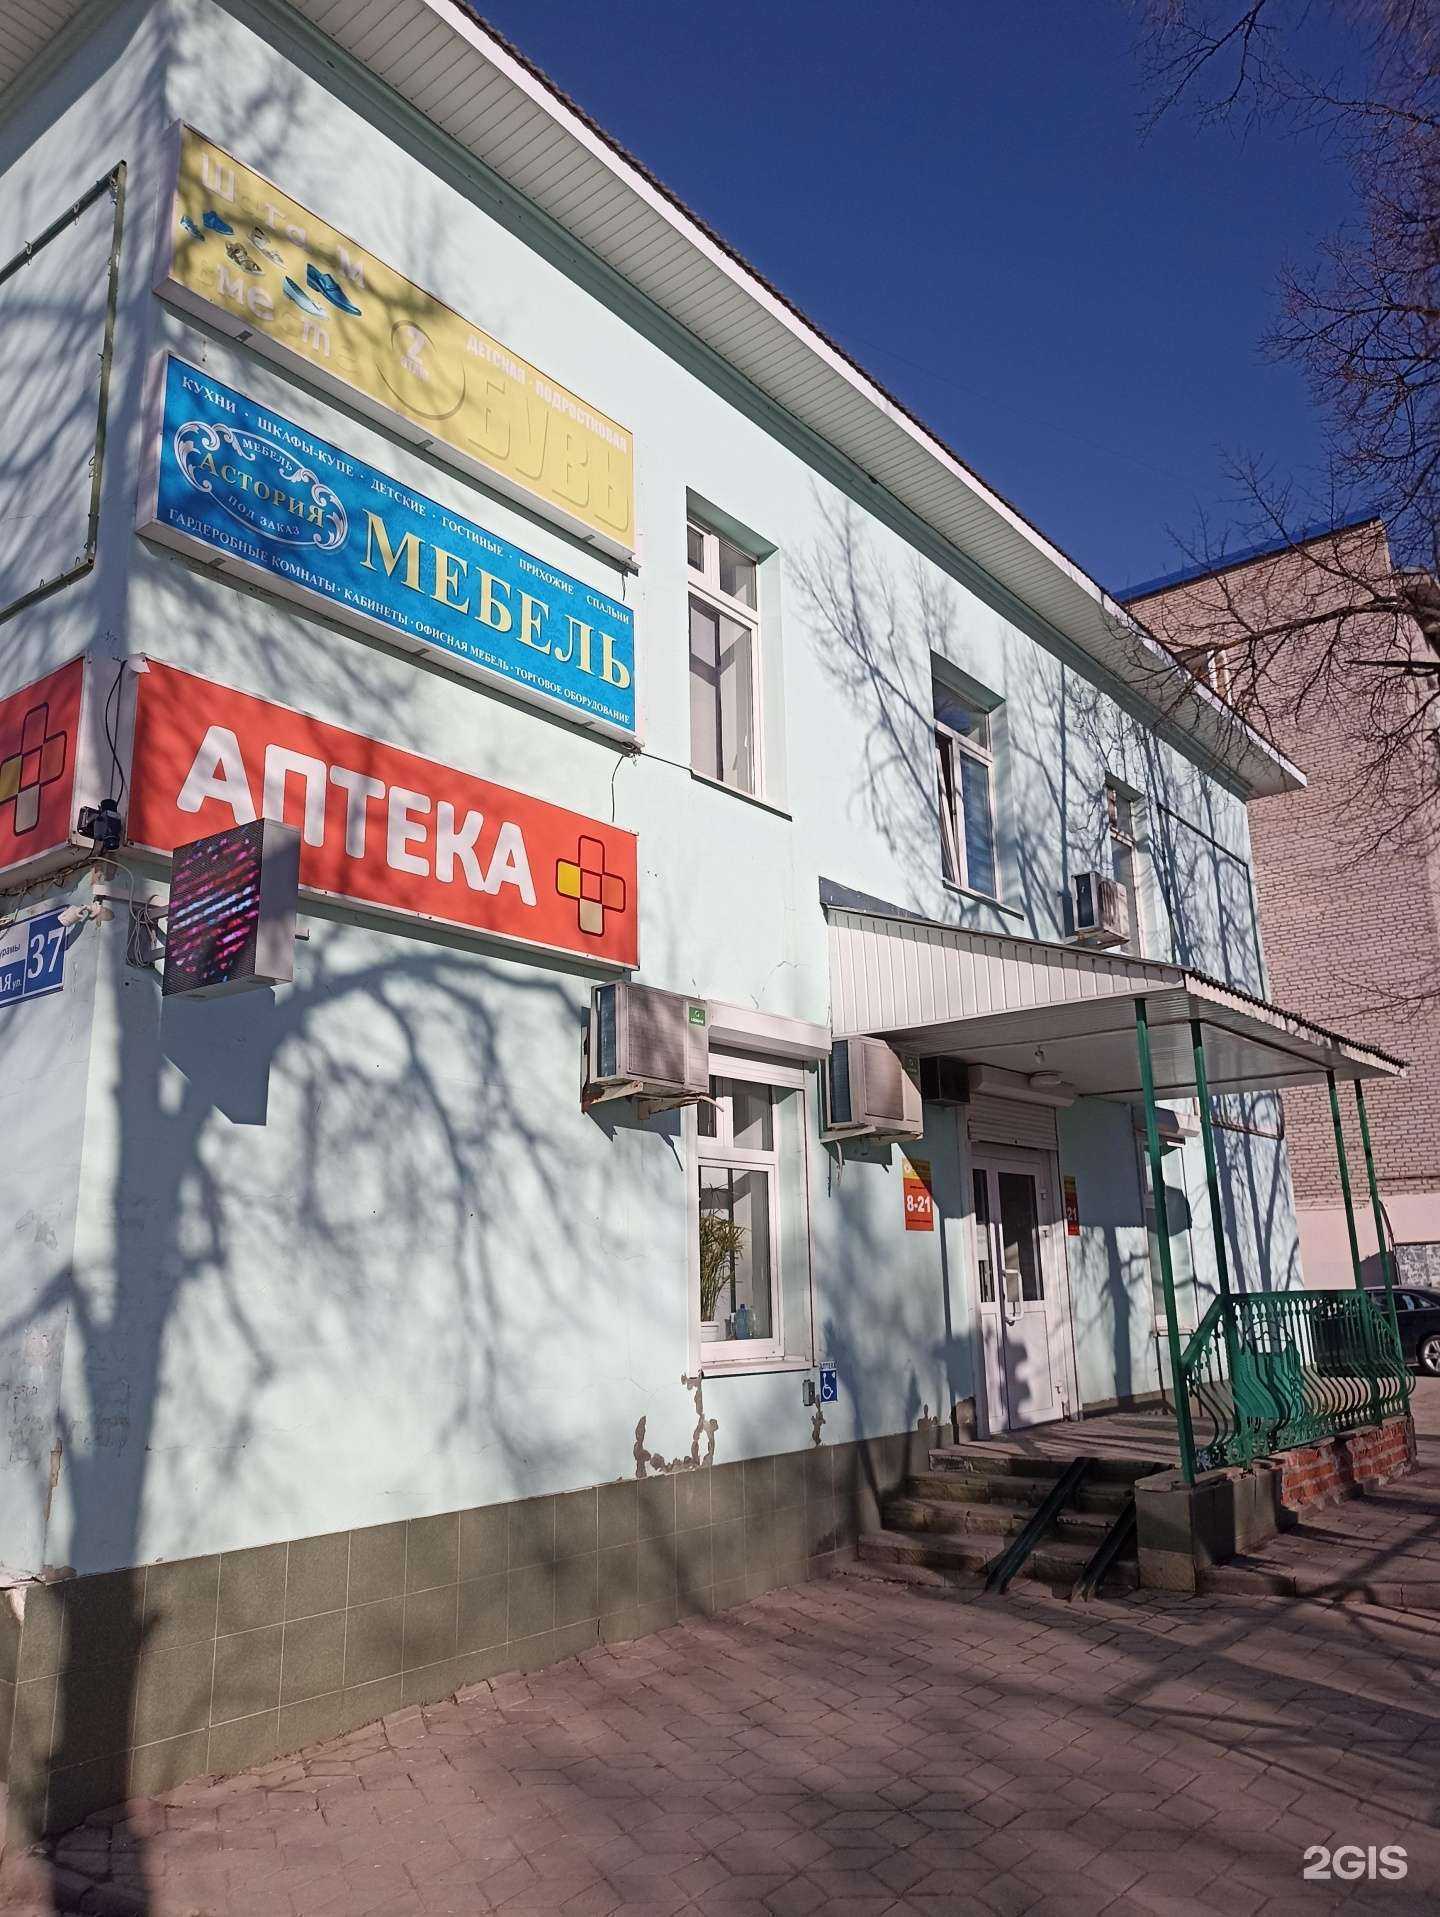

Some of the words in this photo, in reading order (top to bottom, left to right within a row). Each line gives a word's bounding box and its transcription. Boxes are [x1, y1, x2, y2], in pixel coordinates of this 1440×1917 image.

[199, 451, 326, 529] АСТОРИЯ
[241, 437, 294, 472] МЕБЕЛЬ
[182, 375, 237, 414] КУХНИ
[257, 416, 355, 478] ШКАФЫ-КУПЕ
[370, 478, 427, 518] ДЕТСКИЕ
[441, 516, 504, 558] ГОСТИНЫЕ
[518, 557, 575, 596] ПРИХОЖИЕ
[586, 594, 630, 625] СПАЛЬНИ
[227, 494, 256, 520] ПОД
[259, 515, 301, 537] ЗАКАЗ
[168, 507, 269, 563] ГАРДЕРОБНЫЕ
[271, 554, 336, 594] КОМНАТЫ
[343, 587, 409, 626] КАБИНЕТЫ
[415, 620, 468, 653] ОФИСНАЯ
[470, 643, 510, 672] МЕБЕЛЬ
[514, 665, 563, 697] ТОРГОВОЕ
[563, 687, 631, 725] ОБОРУДОВАНИЕ
[359, 508, 632, 690] МЕБЕЛЬ
[176, 725, 538, 908] АПТЕКА
[27, 925, 65, 979] 37
[906, 1194, 931, 1213] 8-21
